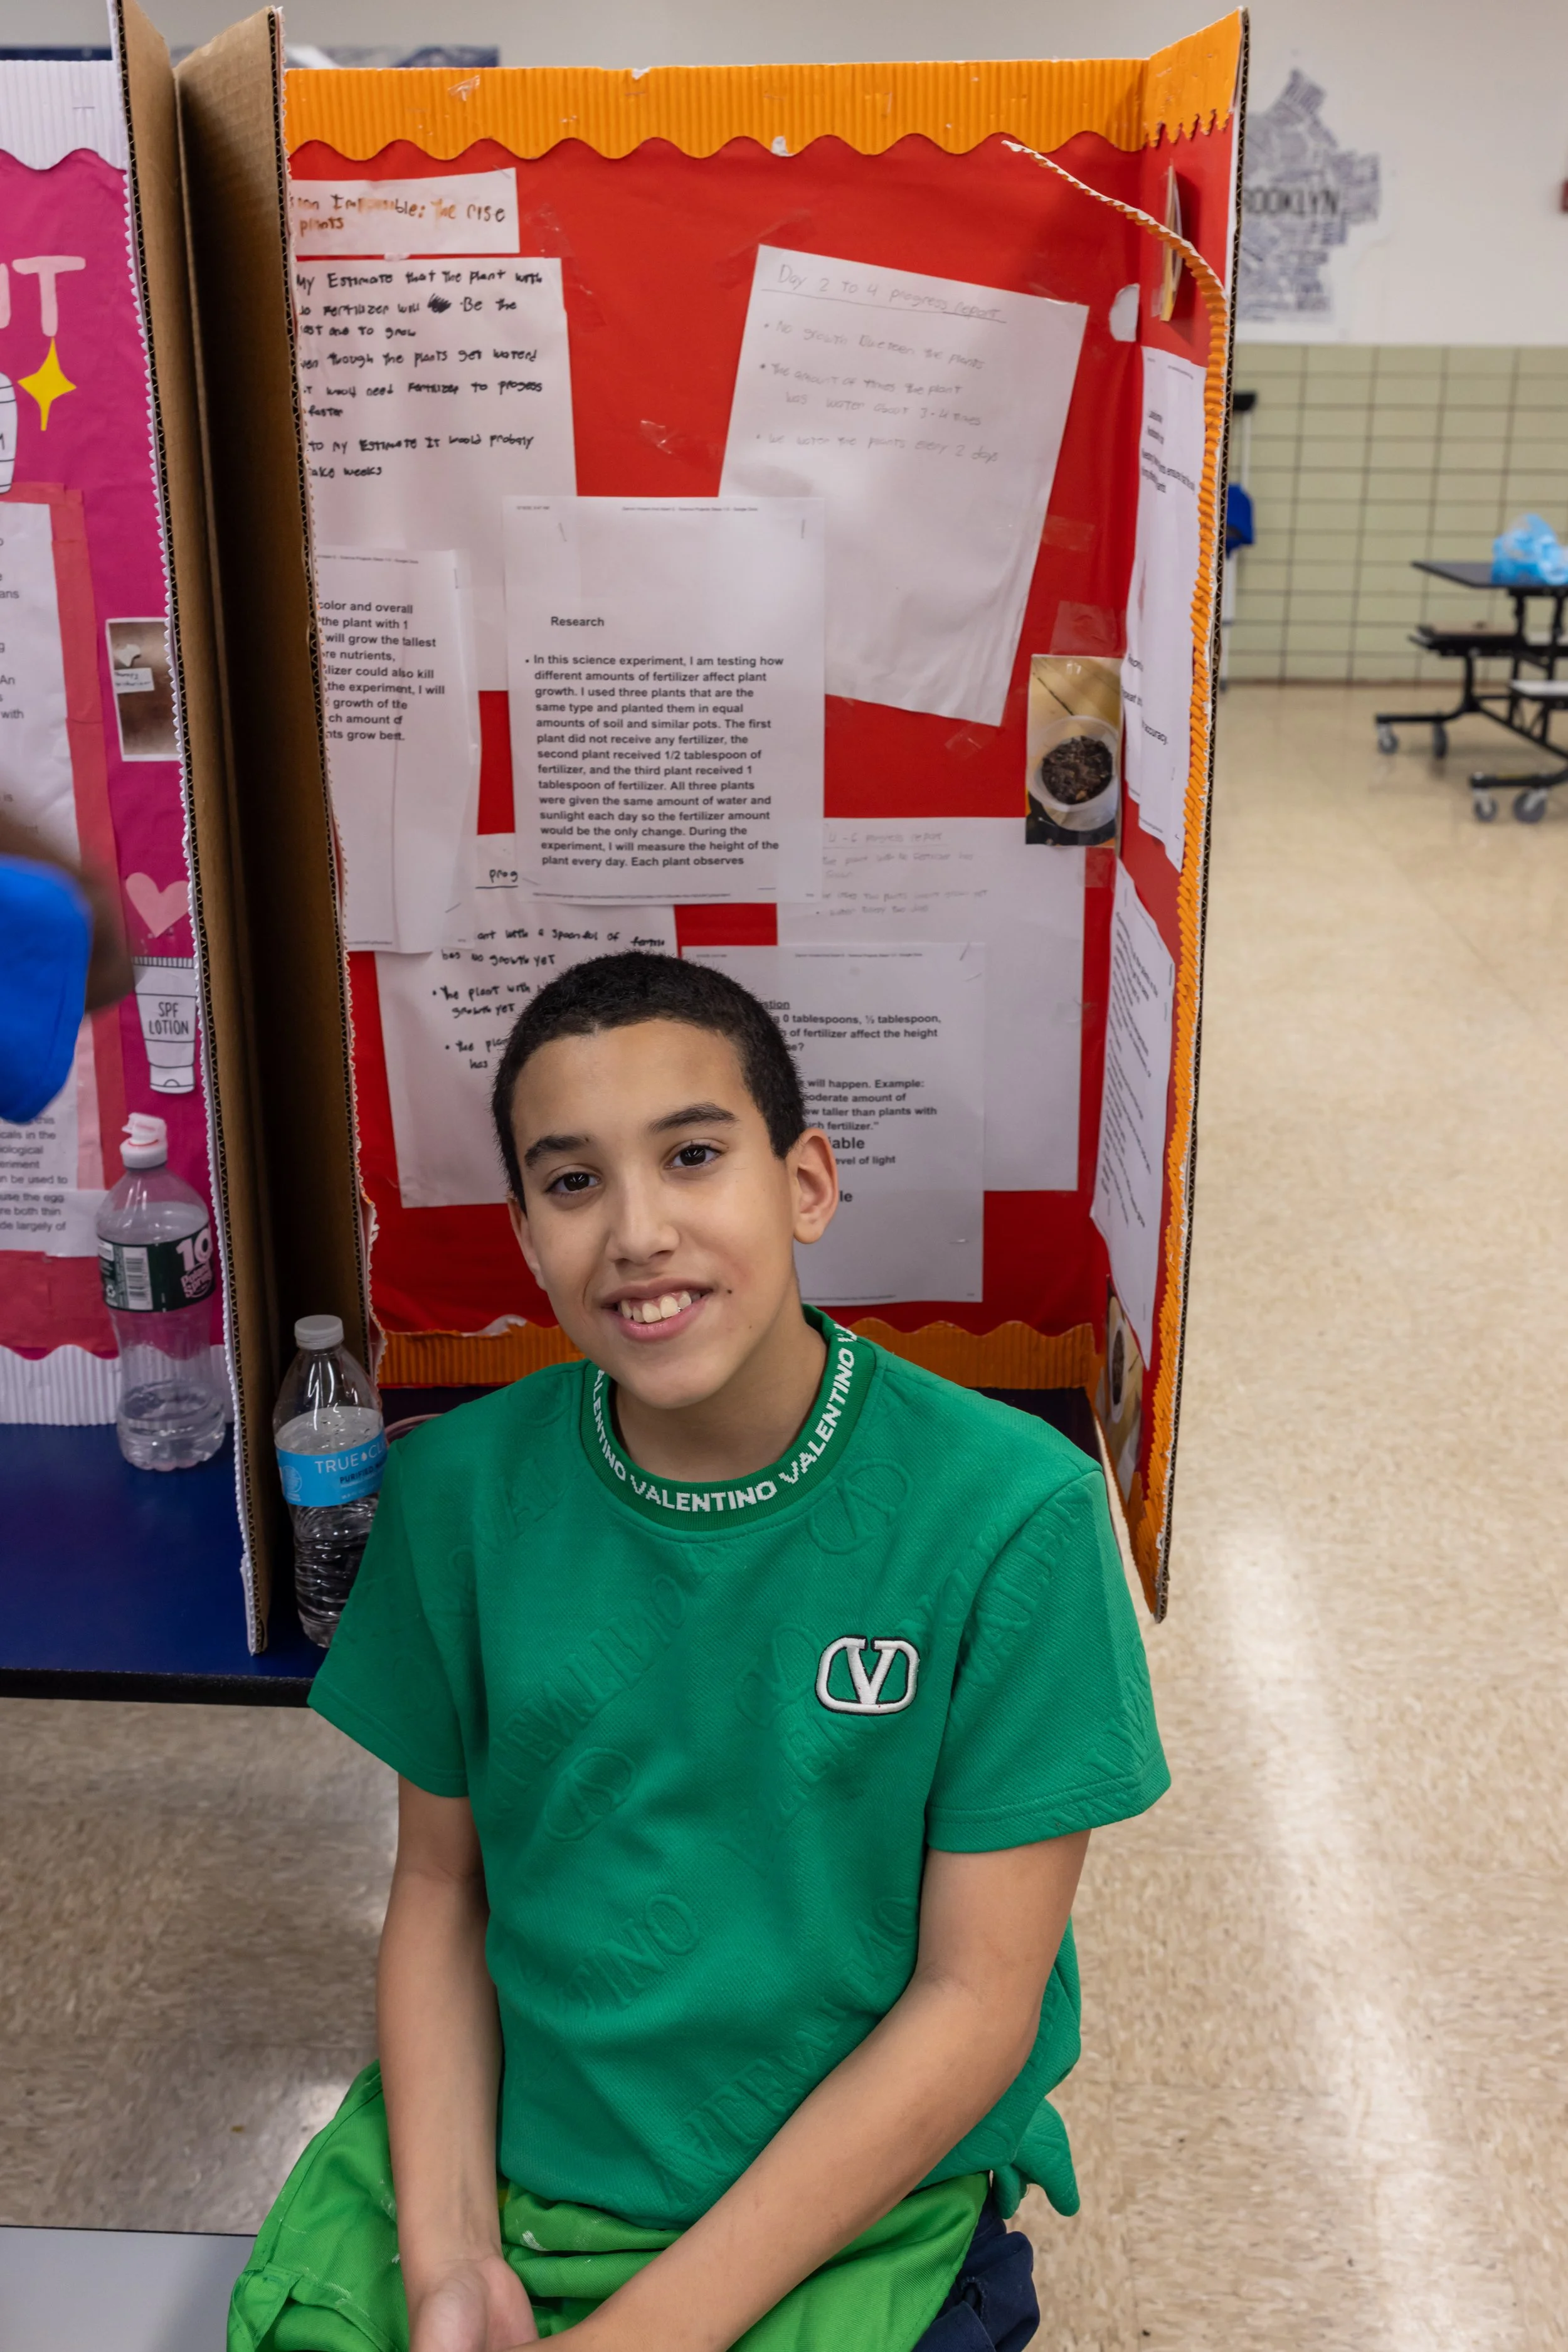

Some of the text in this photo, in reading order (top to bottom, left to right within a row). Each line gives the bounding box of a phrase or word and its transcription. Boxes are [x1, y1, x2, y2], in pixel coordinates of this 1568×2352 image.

[405, 270, 437, 284] that
[777, 263, 807, 290] Day
[818, 278, 830, 292] 2
[867, 284, 877, 297] 4
[889, 289, 948, 310] progress
[366, 384, 394, 396] need
[349, 601, 372, 612] and
[374, 604, 413, 615] overall
[322, 617, 408, 630] the plant with 1
[550, 616, 605, 627] Research
[326, 633, 437, 647] will grow the tallest
[339, 650, 396, 662] nutrients,
[533, 654, 784, 669] In this science experiment, I am testing how
[326, 665, 434, 679] lizer could also kill
[534, 670, 767, 684] different amounts of fertilizer affect plant
[327, 682, 445, 696] the experiment, I will
[332, 698, 408, 710] growth of the
[1, 709, 24, 719] with
[346, 715, 403, 725] amount of
[536, 718, 771, 731] amounts of soil and similar pots. The first
[346, 731, 376, 742] grow
[379, 730, 405, 741] best.
[537, 749, 762, 762] second plant received 1/2 tablespoon of
[538, 779, 755, 792] tablespoon of fertilizer. All three plants
[540, 840, 780, 853] experiment, I will measure the height of the
[158, 1001, 179, 1017] SPF
[782, 1014, 790, 1023] 0
[792, 1014, 862, 1025] tablespoons,
[877, 1014, 941, 1025] tablespoon,
[149, 1019, 189, 1036] LOTION
[788, 1028, 938, 1040] of fertilizer affect the height
[807, 1079, 924, 1091] will happen. Example:
[851, 1093, 893, 1103] amount
[894, 1092, 907, 1102] of
[822, 1106, 938, 1118] taller than plants with
[38, 1130, 56, 1140] the
[858, 1155, 870, 1165] of
[872, 1155, 896, 1167] light
[28, 1175, 54, 1184] used
[14, 1207, 61, 1216] both thin
[16, 1221, 66, 1233] largely of
[593, 1348, 855, 1513] ALENTINO VALENTINO VALENTINO
[315, 1453, 359, 1474] TRUE
[340, 1466, 374, 1484] PURIFIED
